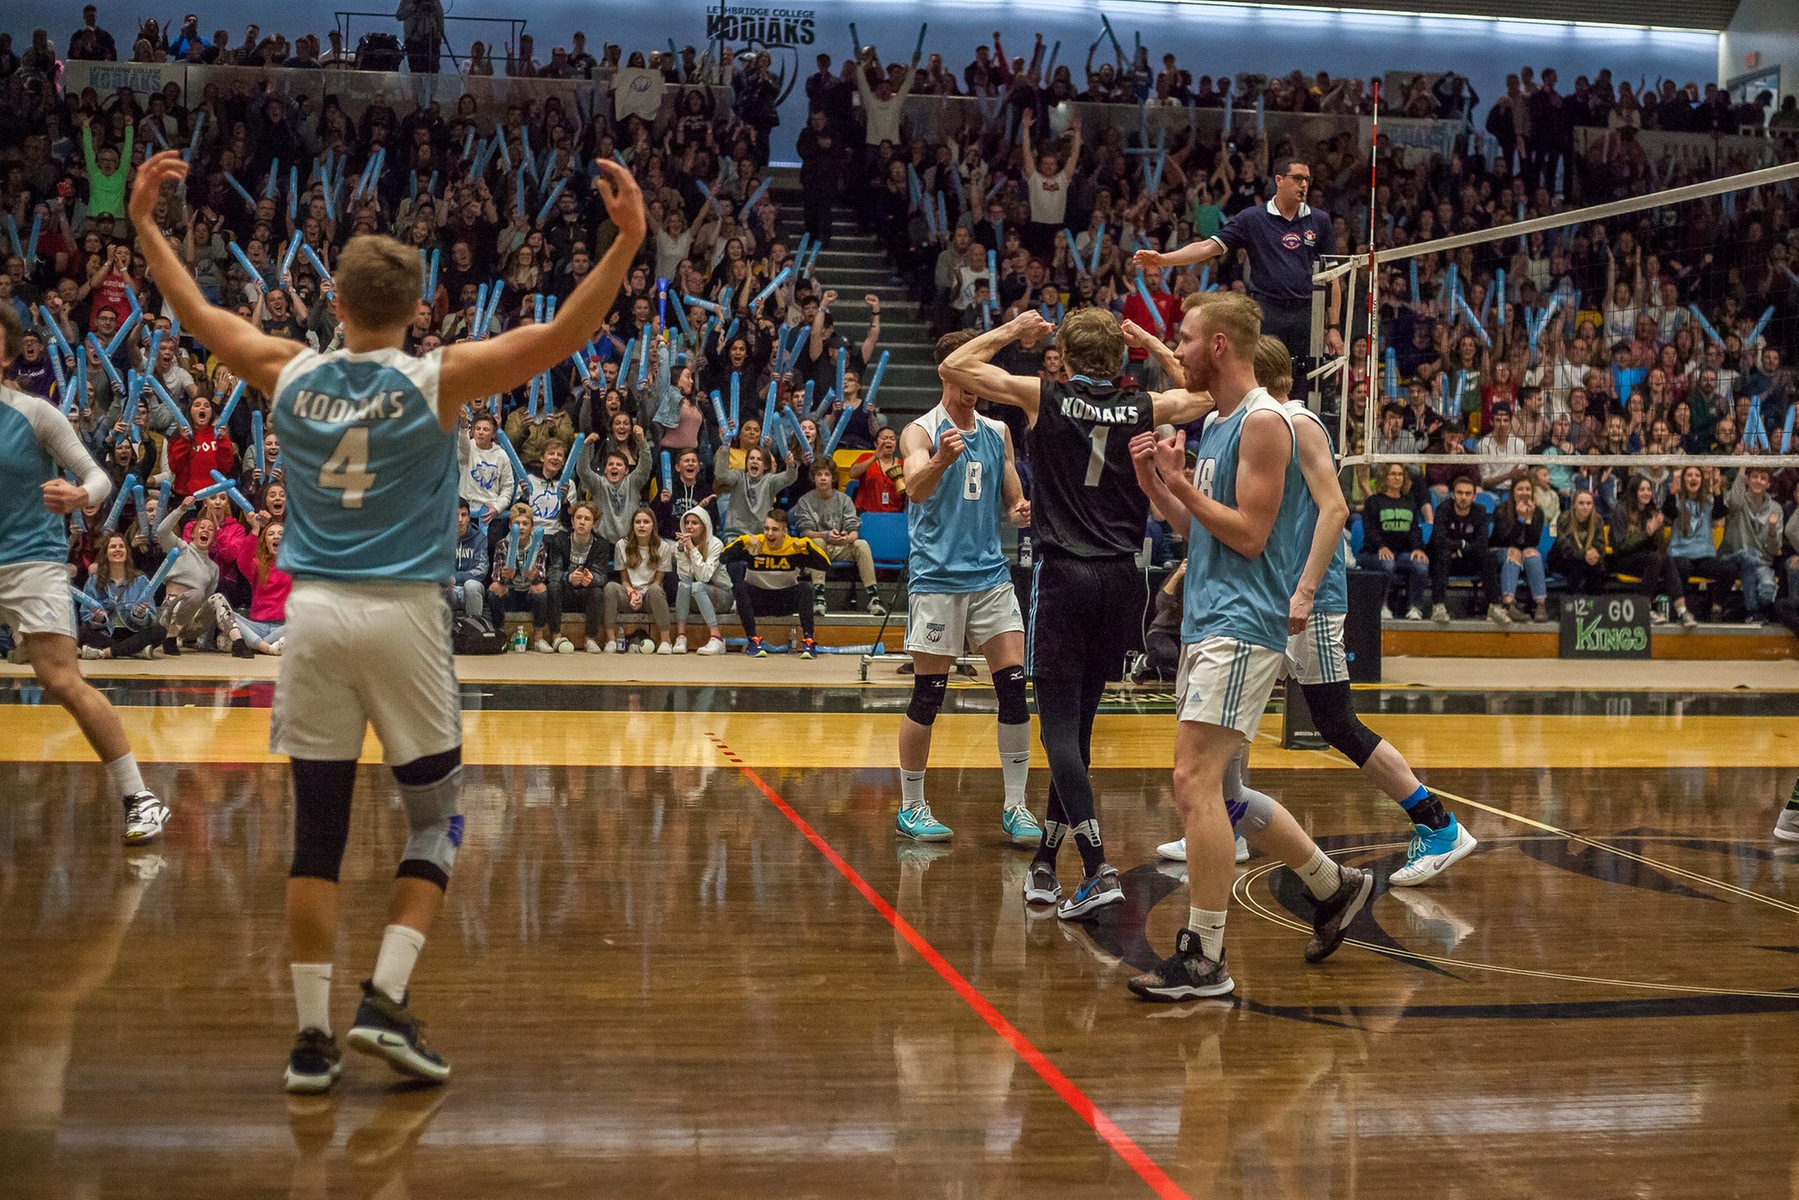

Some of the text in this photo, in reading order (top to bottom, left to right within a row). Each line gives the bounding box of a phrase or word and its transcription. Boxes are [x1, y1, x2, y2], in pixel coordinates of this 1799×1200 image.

[706, 5, 815, 18] LEHBRIDGE COLLEGE
[706, 15, 815, 45] KODIAKS
[1060, 397, 1139, 424] KODIAKS
[319, 426, 377, 508] 4
[1084, 425, 1111, 487] 1
[963, 460, 983, 501] 8
[754, 556, 791, 570] FILA
[1608, 599, 1635, 622] GO
